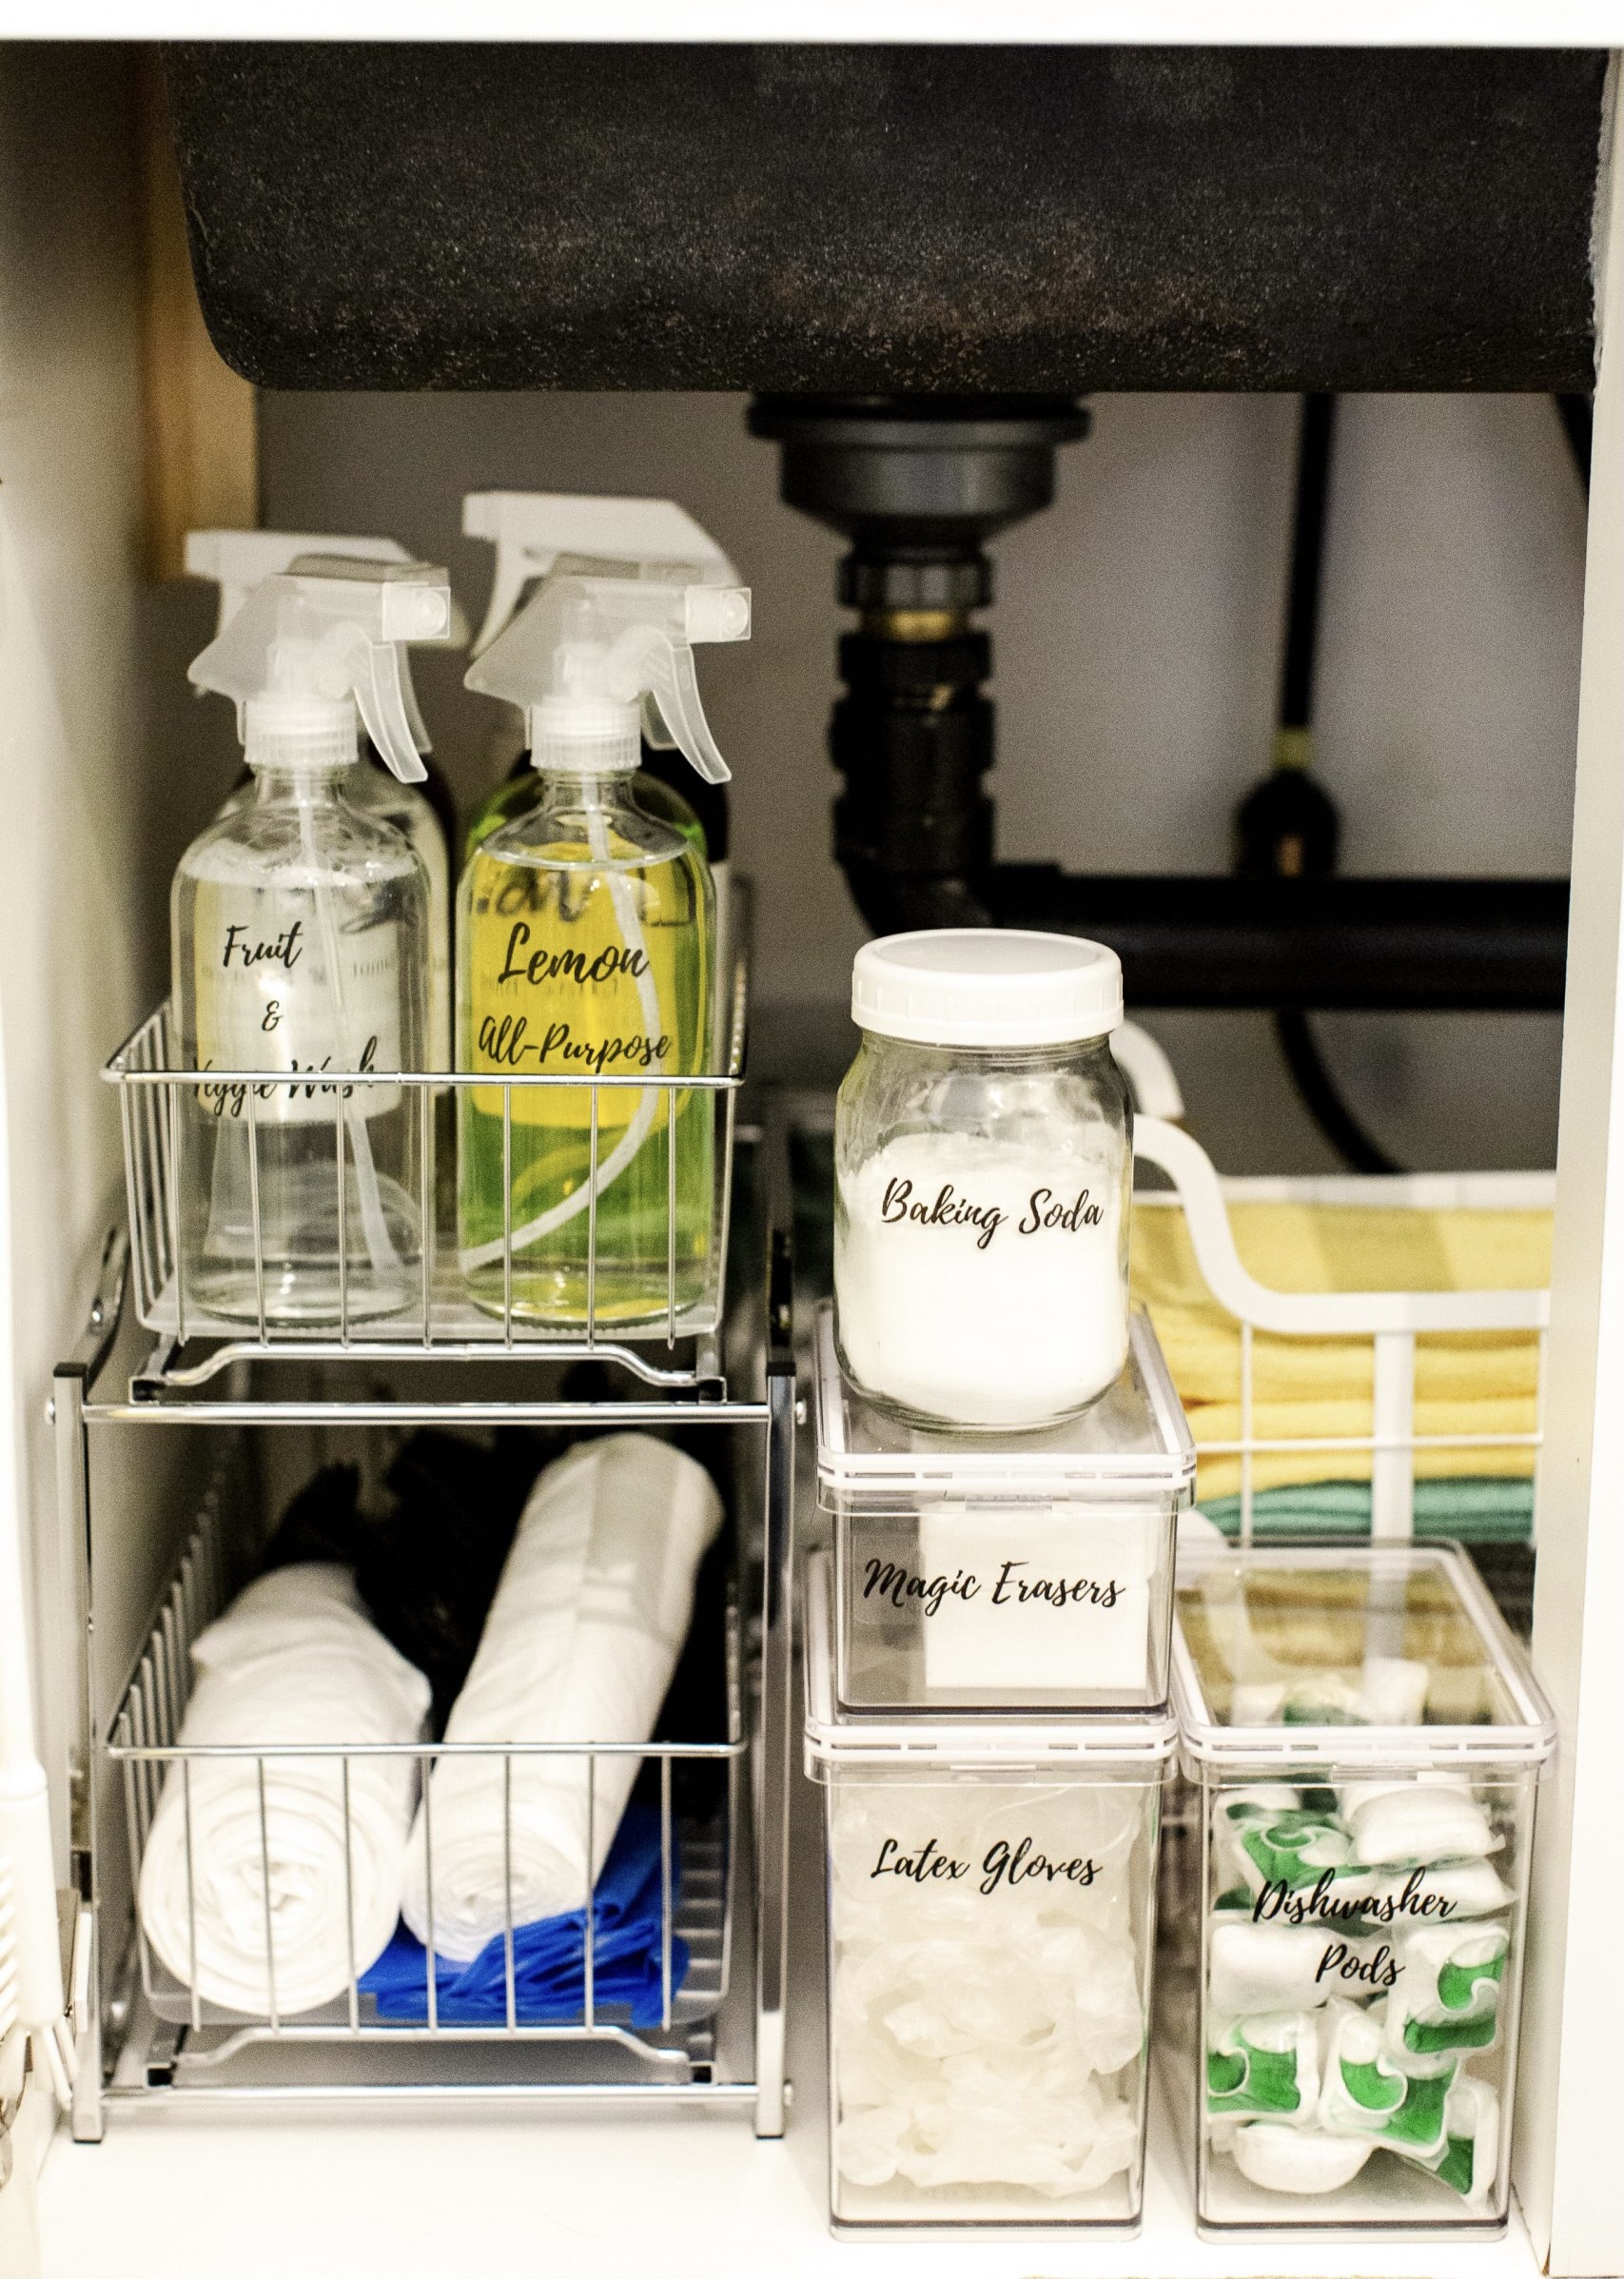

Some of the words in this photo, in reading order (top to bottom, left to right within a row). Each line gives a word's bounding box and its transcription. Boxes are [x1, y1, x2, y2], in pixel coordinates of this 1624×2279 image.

[223, 920, 303, 969] Fruit
[498, 921, 650, 985] Lemon
[261, 1000, 284, 1031] &
[479, 1014, 672, 1074] All-Purpose
[882, 1177, 1008, 1249] Baking
[1019, 1188, 1104, 1234] Soda
[863, 1559, 982, 1617] Magic
[992, 1562, 1126, 1608] Erasers
[871, 1838, 970, 1882] Latex
[980, 1837, 1104, 1895] Gloves
[1252, 1867, 1458, 1924] Dishwasher
[1315, 1943, 1406, 1987] Pods
